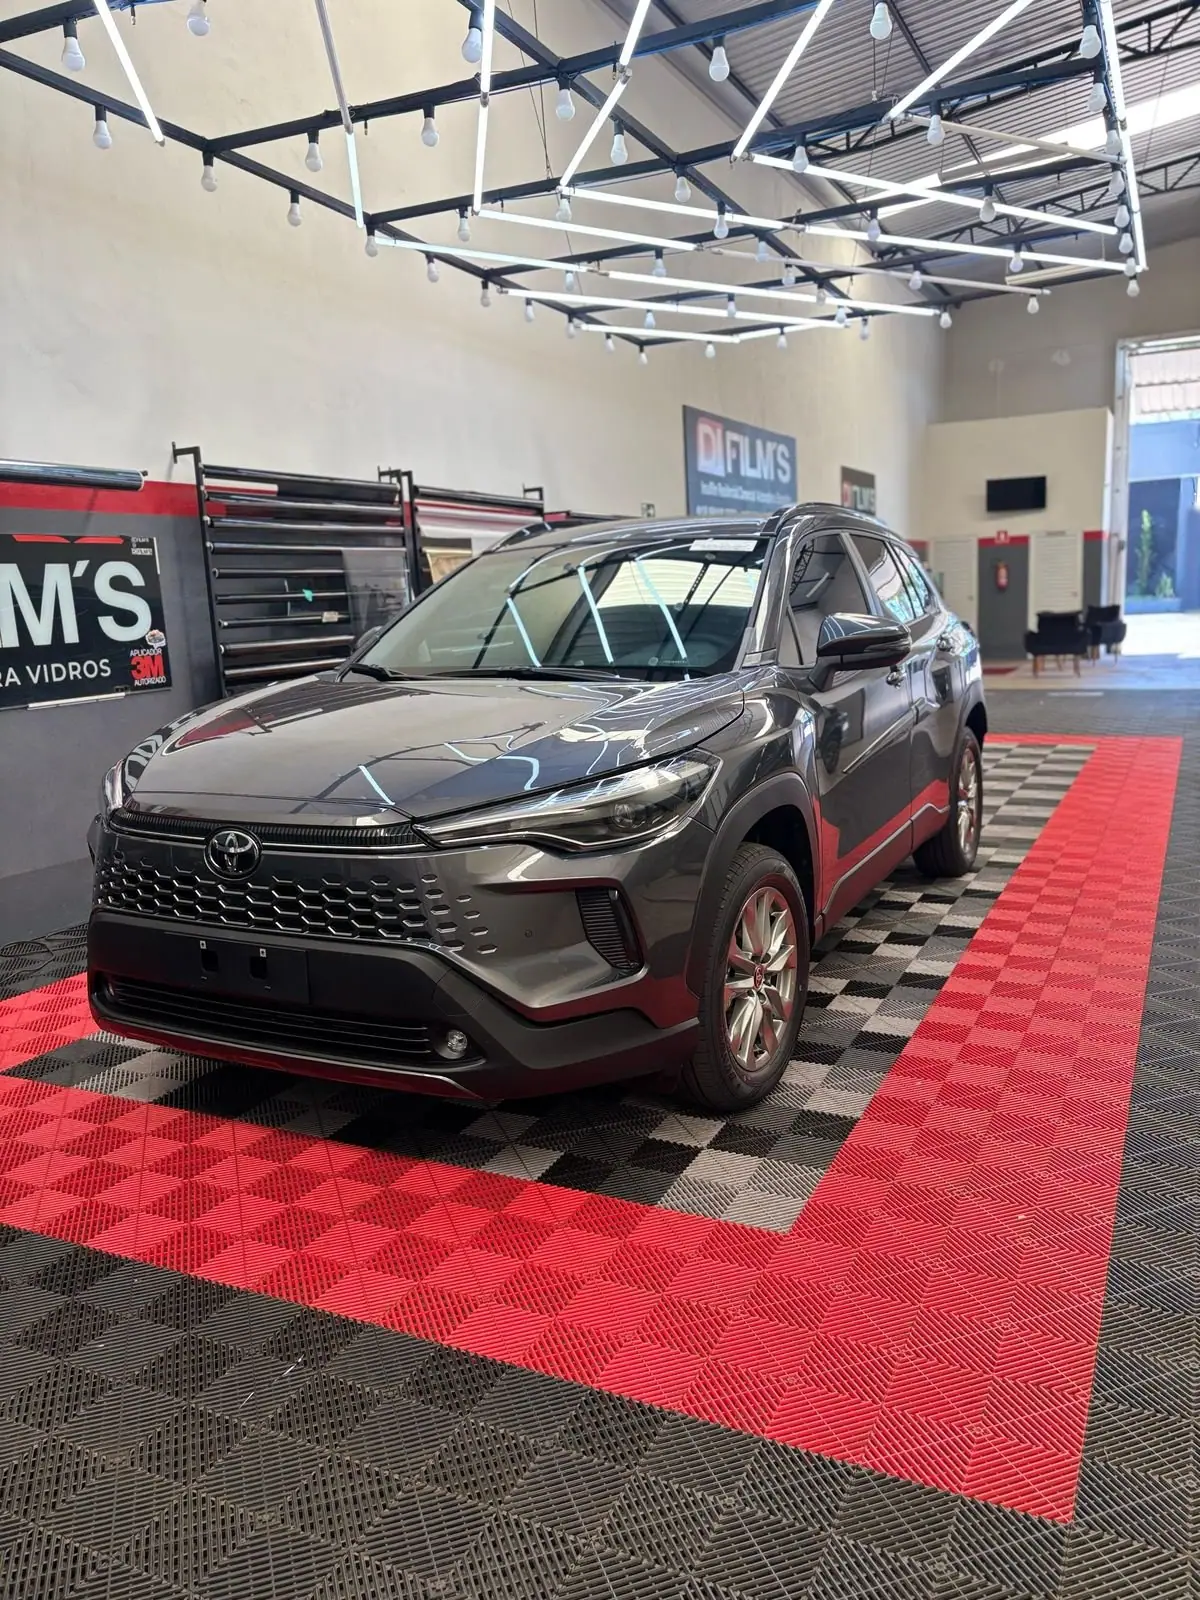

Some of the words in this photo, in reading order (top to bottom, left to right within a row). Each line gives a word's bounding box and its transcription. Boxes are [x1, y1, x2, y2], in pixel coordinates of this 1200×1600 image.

[0, 559, 152, 648] M'S
[130, 647, 162, 657] APLICADOR
[25, 658, 111, 685] VIDROS
[131, 655, 164, 680] 3M
[134, 676, 166, 687] AUTORIZADO
